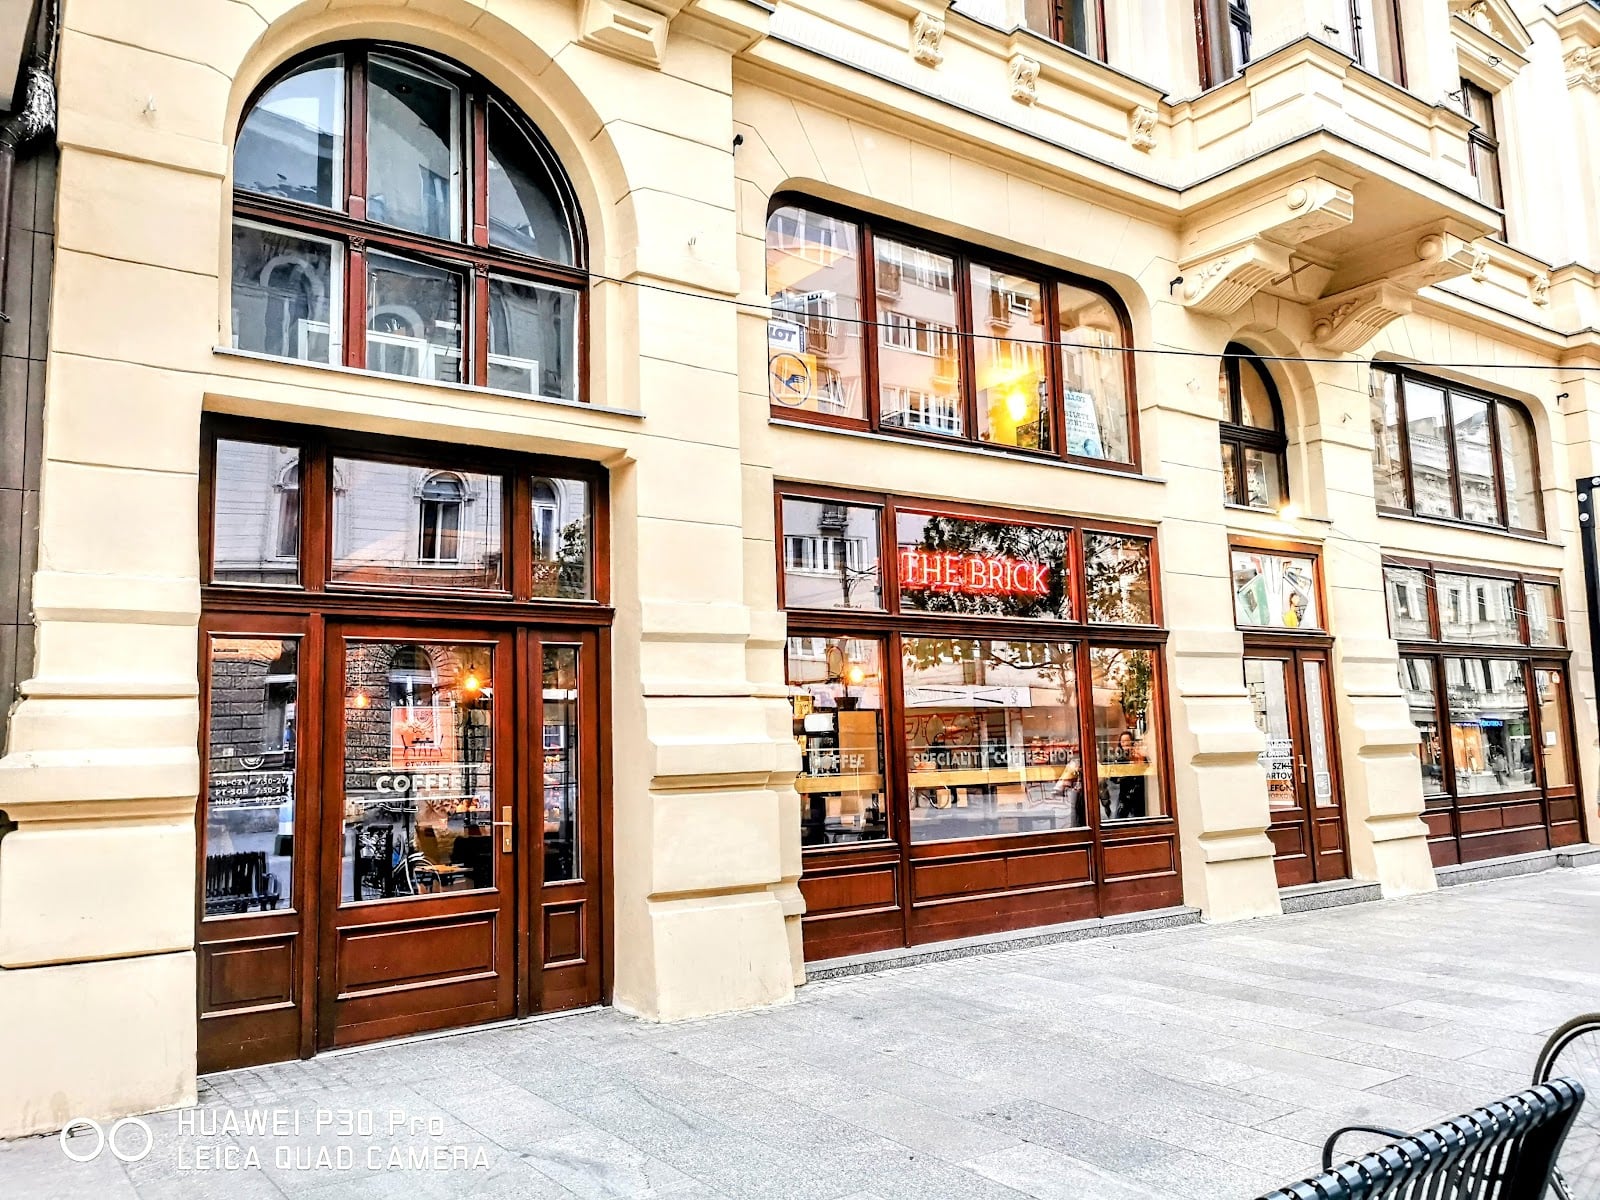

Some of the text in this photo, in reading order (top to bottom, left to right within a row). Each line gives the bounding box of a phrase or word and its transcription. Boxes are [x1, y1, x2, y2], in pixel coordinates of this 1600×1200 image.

[769, 326, 796, 342] LOT
[901, 552, 1050, 593] THE BRICK
[1310, 669, 1323, 769] TELEFONY
[913, 748, 1074, 767] SPECIALITY COFFEE SHOP
[215, 778, 252, 786] PN-CZW
[376, 774, 463, 793] COFFEE
